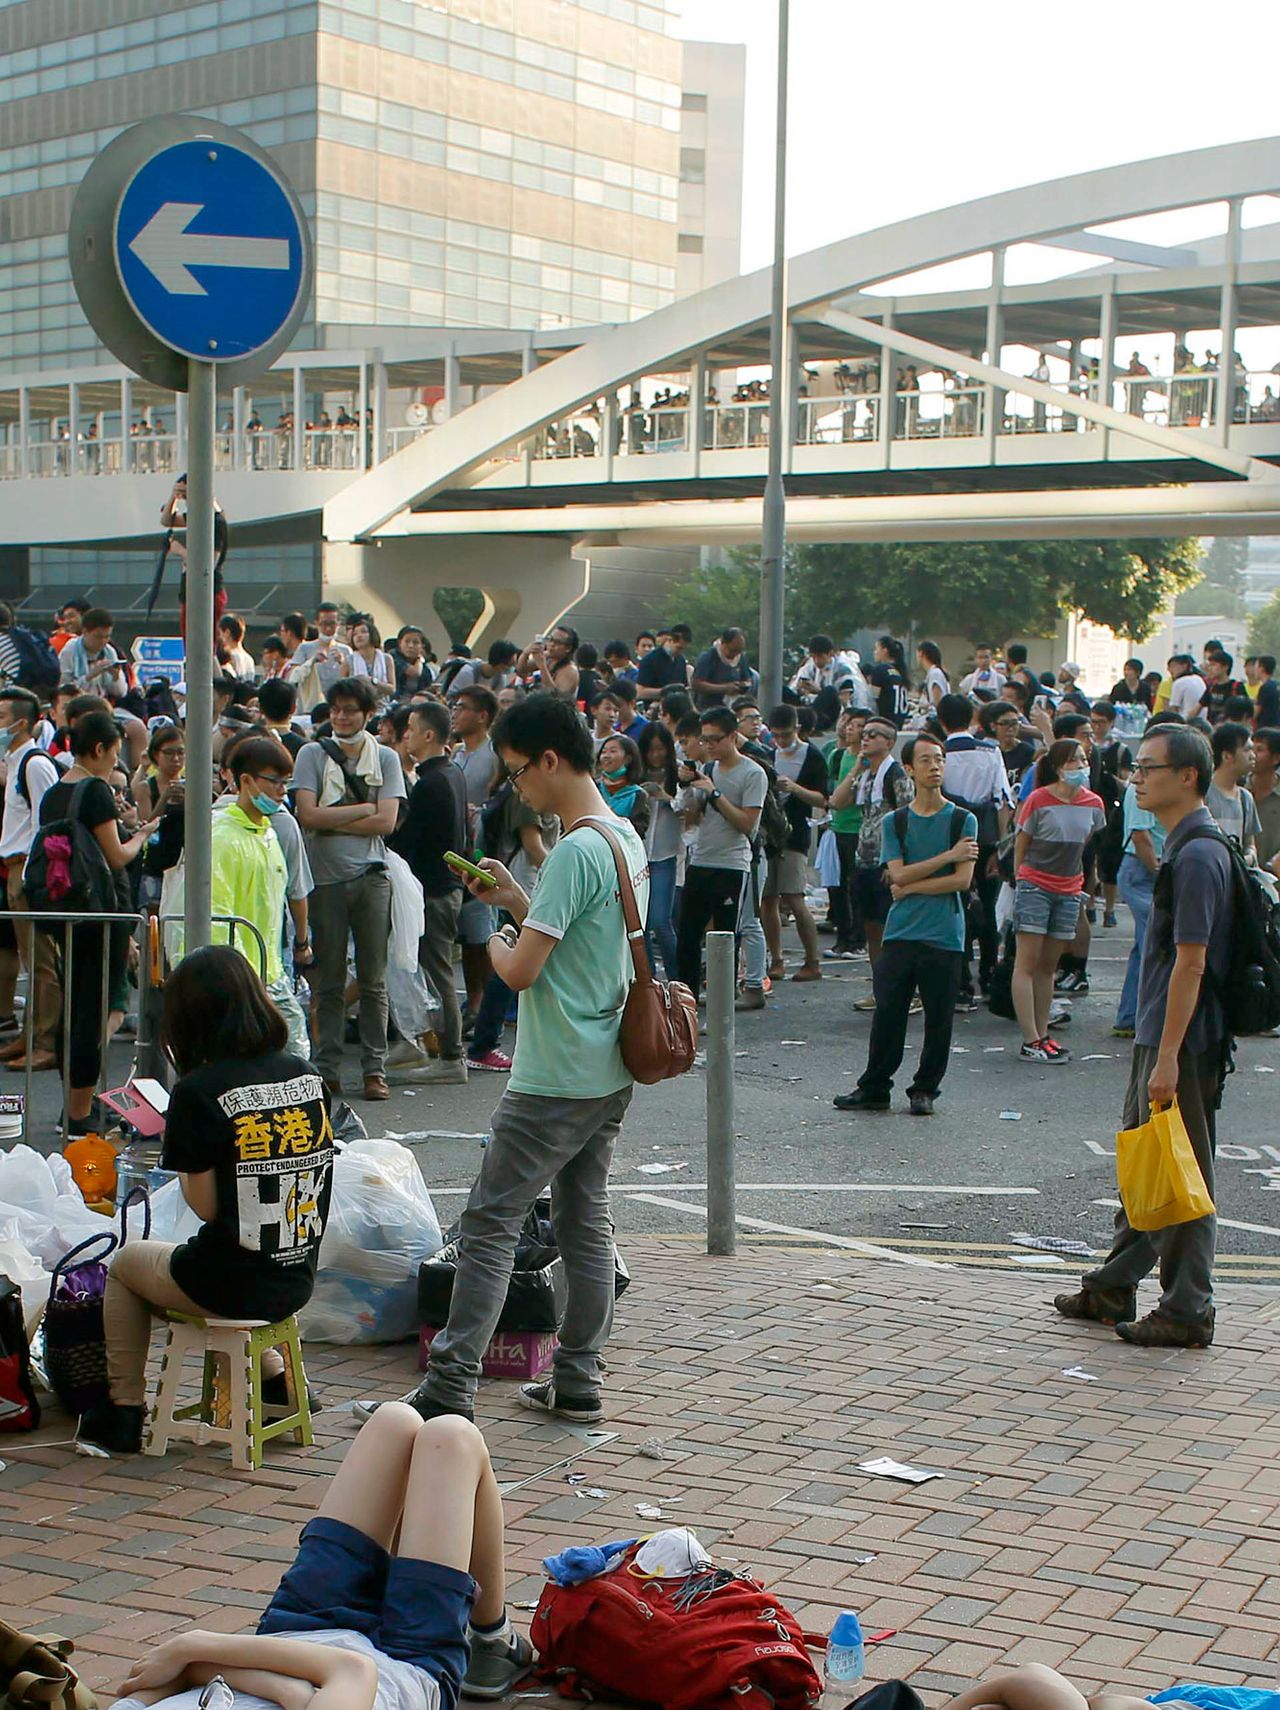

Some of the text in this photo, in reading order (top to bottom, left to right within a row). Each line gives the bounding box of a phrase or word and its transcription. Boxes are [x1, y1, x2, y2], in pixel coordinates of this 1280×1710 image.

[222, 1078, 323, 1116] 保護瀕危物
[234, 1107, 334, 1160] 香港人
[237, 1161, 275, 1174] PROTECT
[276, 1156, 319, 1169] ENDANGERED
[753, 1644, 795, 1656] osprey
